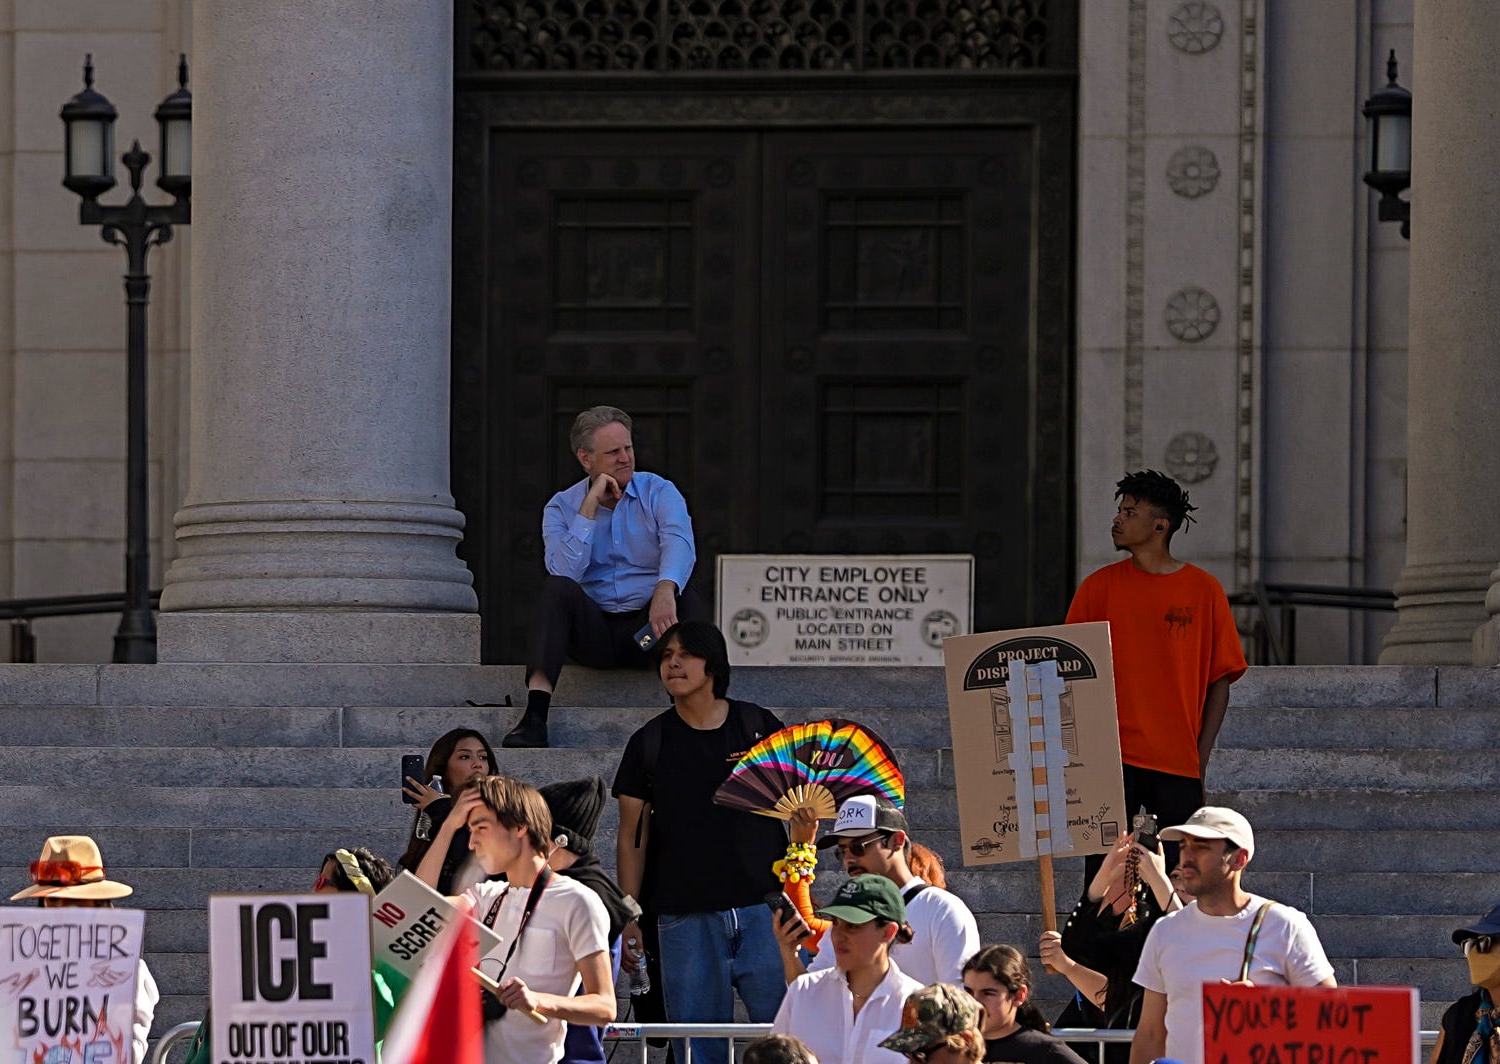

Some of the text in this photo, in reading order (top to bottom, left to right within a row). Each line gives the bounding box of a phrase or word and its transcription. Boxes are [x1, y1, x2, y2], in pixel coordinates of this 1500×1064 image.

[765, 566, 927, 584] CITY EMPLOYEE
[761, 586, 929, 603] ENTRANCE ONLY
[777, 608, 914, 621] PUBLIC ENTRANCE
[797, 622, 893, 636] LOCATED ON
[795, 638, 895, 651] MAIN STREET
[998, 646, 1059, 663] PROJECT
[977, 666, 1009, 681] DISP
[810, 749, 844, 768] YOU
[839, 807, 867, 820] ORK
[373, 902, 406, 929] NO
[3, 923, 129, 962] TOGETHER
[388, 907, 449, 961] SECRET
[239, 902, 334, 1003] ICE
[44, 962, 80, 991] WE
[17, 993, 110, 1038] BURN
[1207, 997, 1373, 1041] YOU'RE NOT
[229, 1020, 350, 1058] OUT OF OUR
